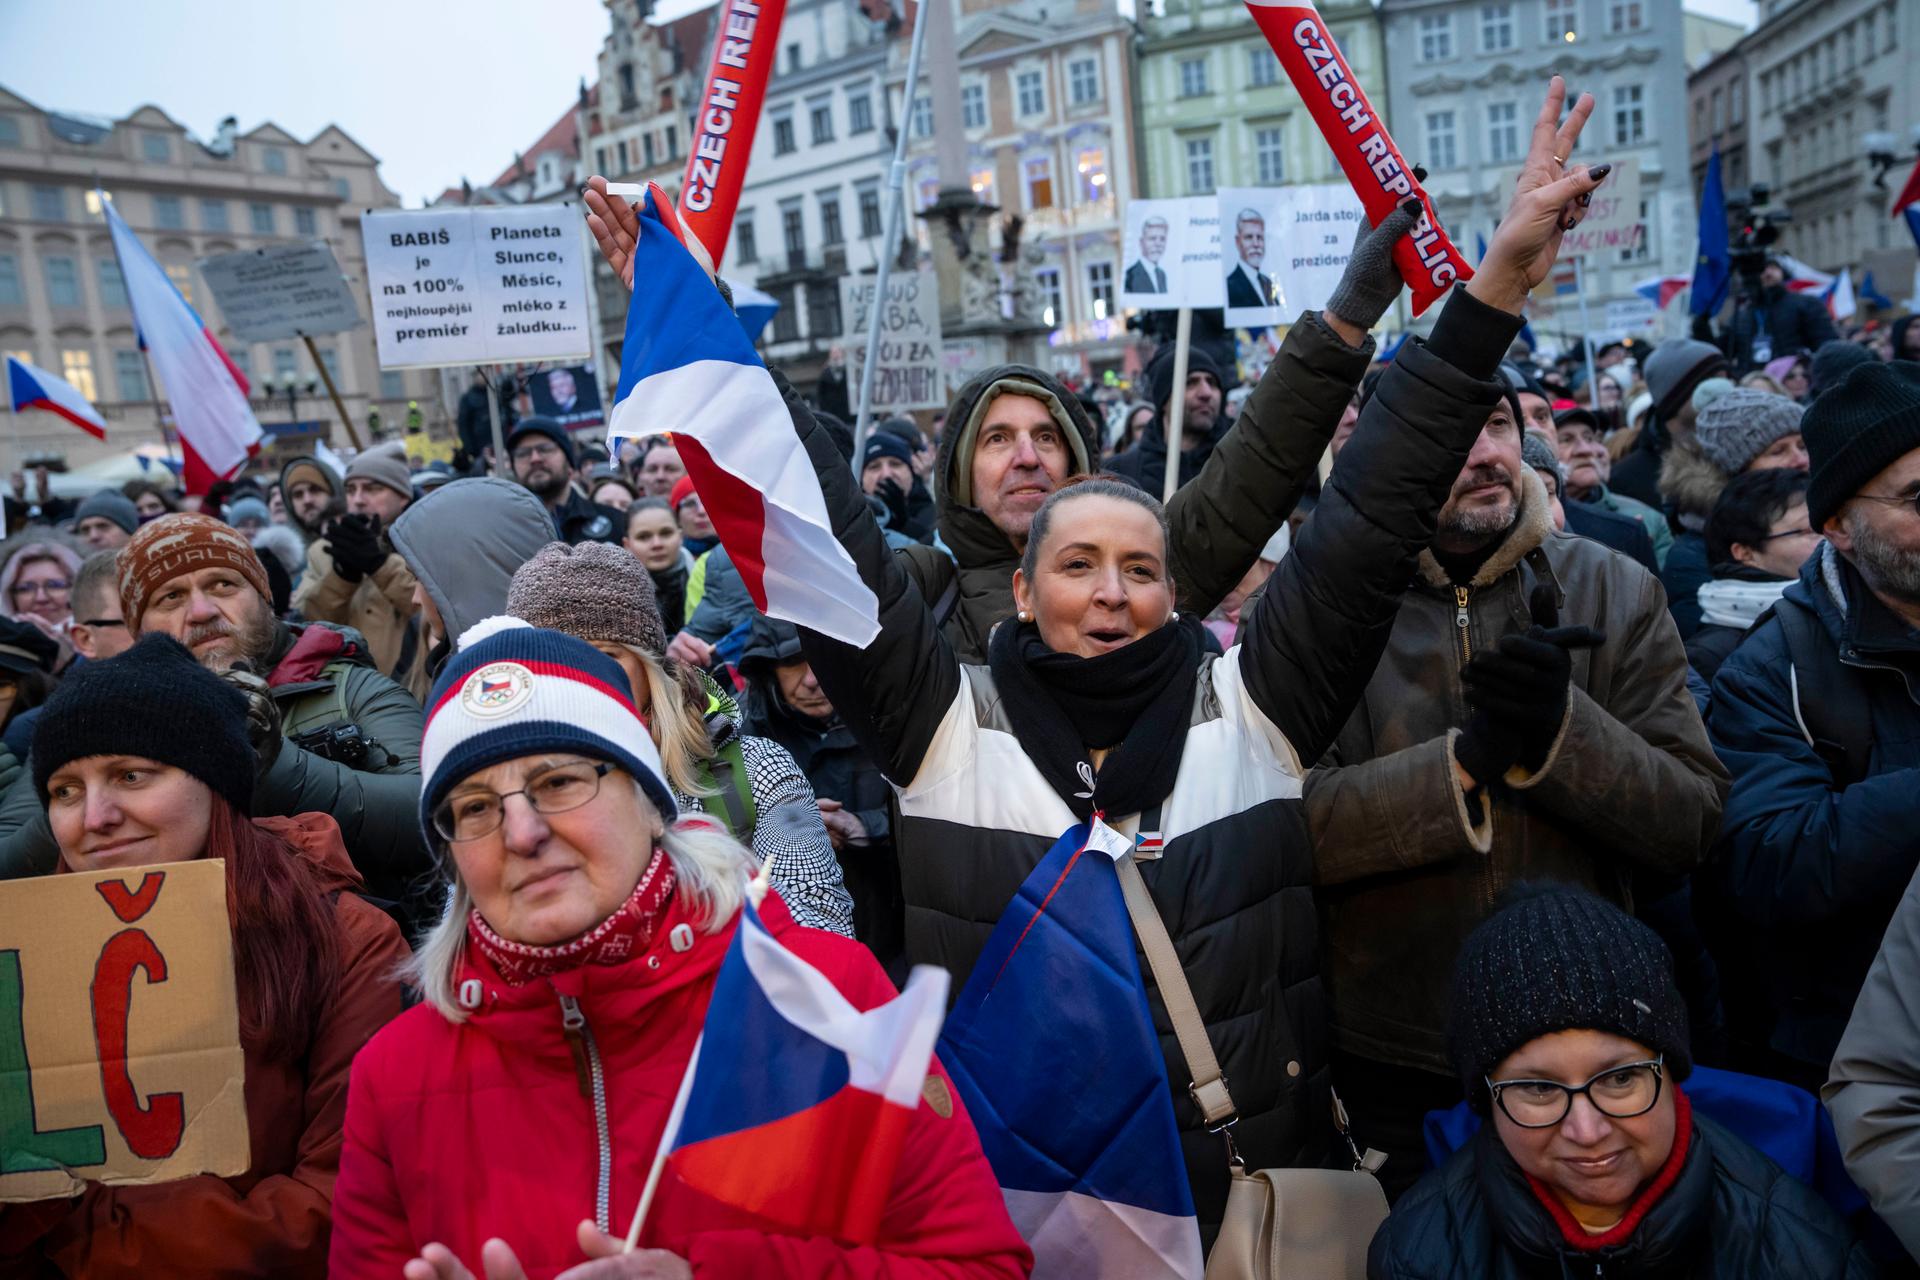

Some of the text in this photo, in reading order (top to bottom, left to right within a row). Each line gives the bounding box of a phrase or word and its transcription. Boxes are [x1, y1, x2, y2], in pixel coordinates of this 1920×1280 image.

[1292, 18, 1372, 134] CZECH
[684, 77, 742, 213] CZECH
[1296, 210, 1330, 222] Jarda
[390, 228, 450, 248] BABIŠ
[490, 225, 562, 241] Planeta
[1324, 235, 1338, 244] za
[415, 257, 431, 270] je
[494, 250, 564, 265] Slunce,
[383, 278, 464, 296] na 100%
[502, 273, 562, 289] Měsíc,
[386, 302, 472, 319] nejhloupější
[502, 299, 567, 313] mléko z
[396, 324, 469, 343] premiér
[497, 319, 577, 336] žaludku...
